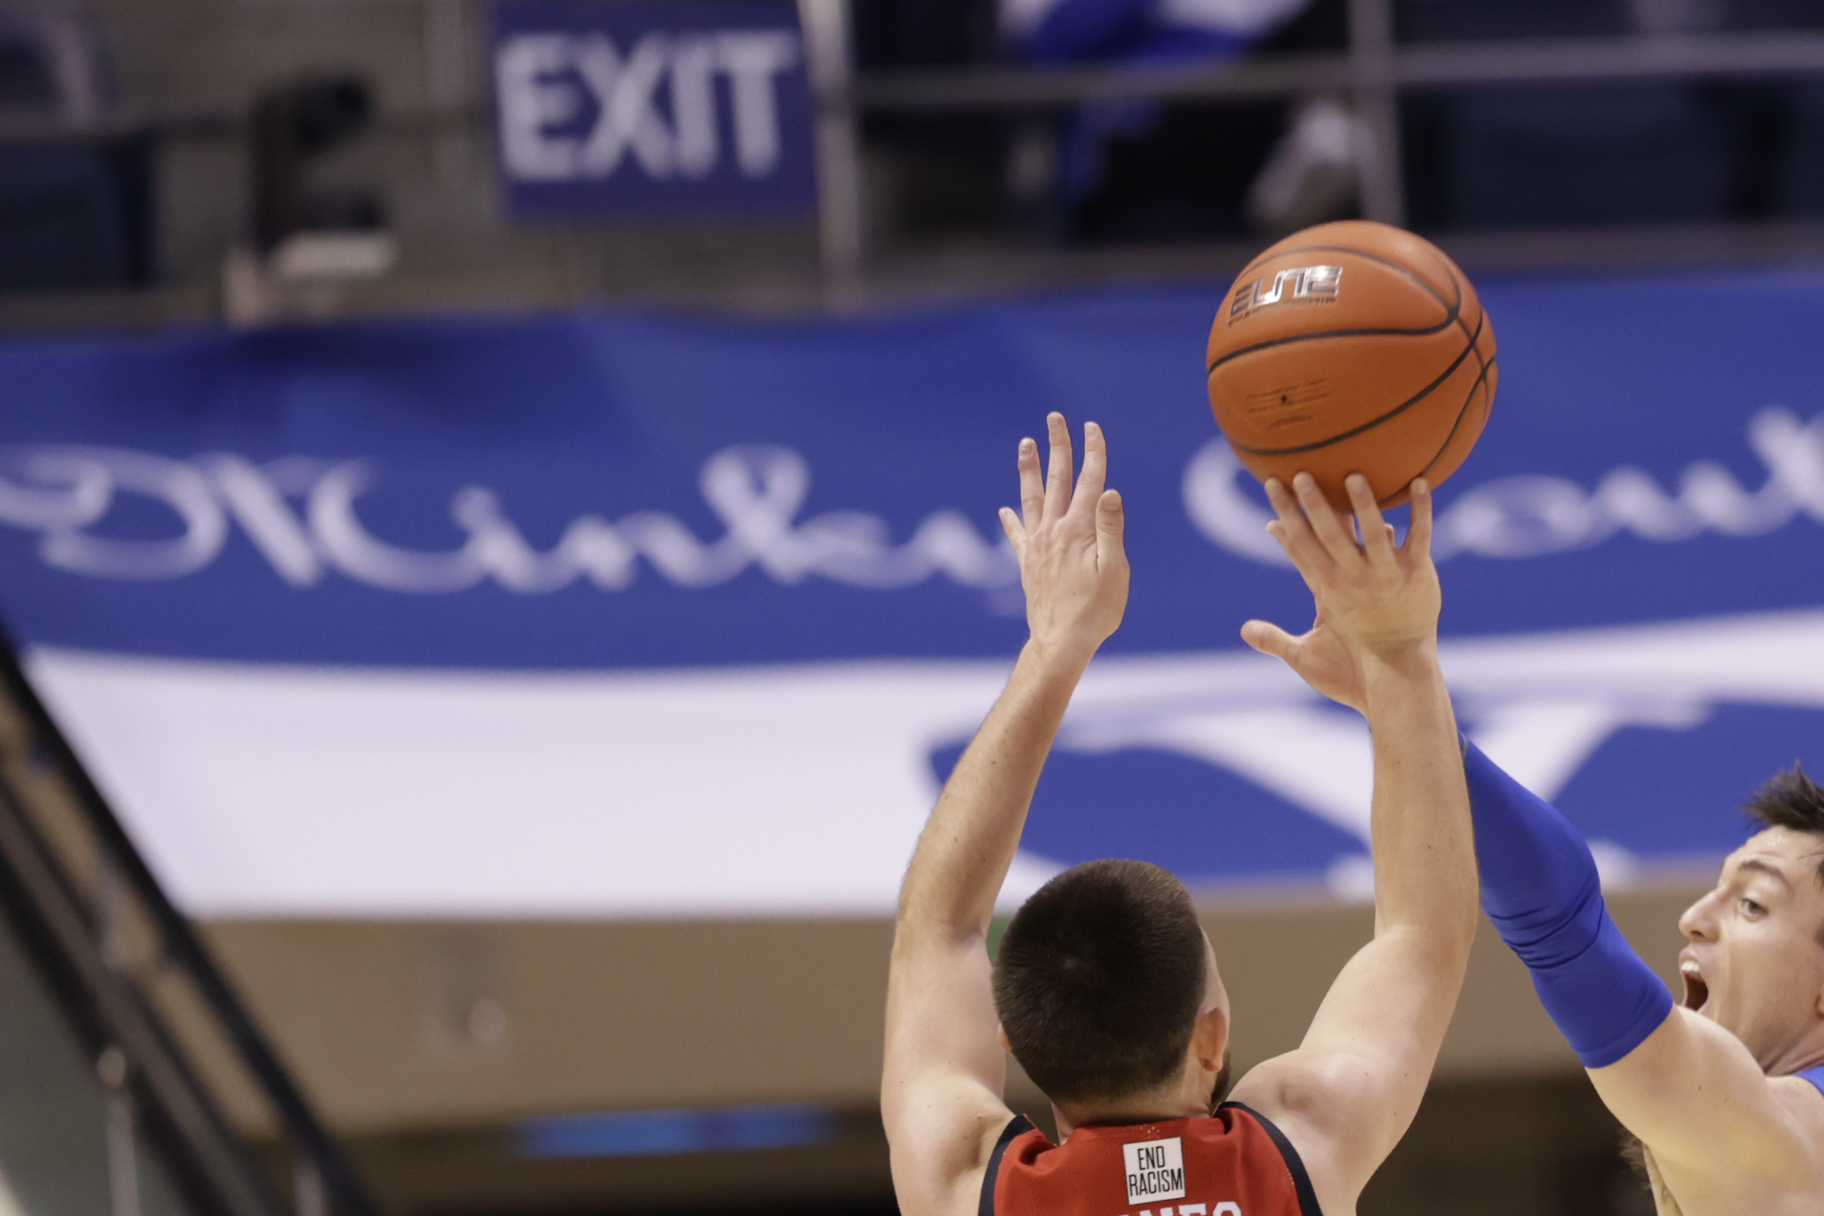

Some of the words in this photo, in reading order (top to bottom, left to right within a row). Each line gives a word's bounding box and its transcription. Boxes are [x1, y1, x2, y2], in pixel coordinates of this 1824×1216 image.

[496, 28, 802, 182] EXIT
[1137, 1146, 1166, 1171] END
[1128, 1167, 1184, 1196] RACISM
